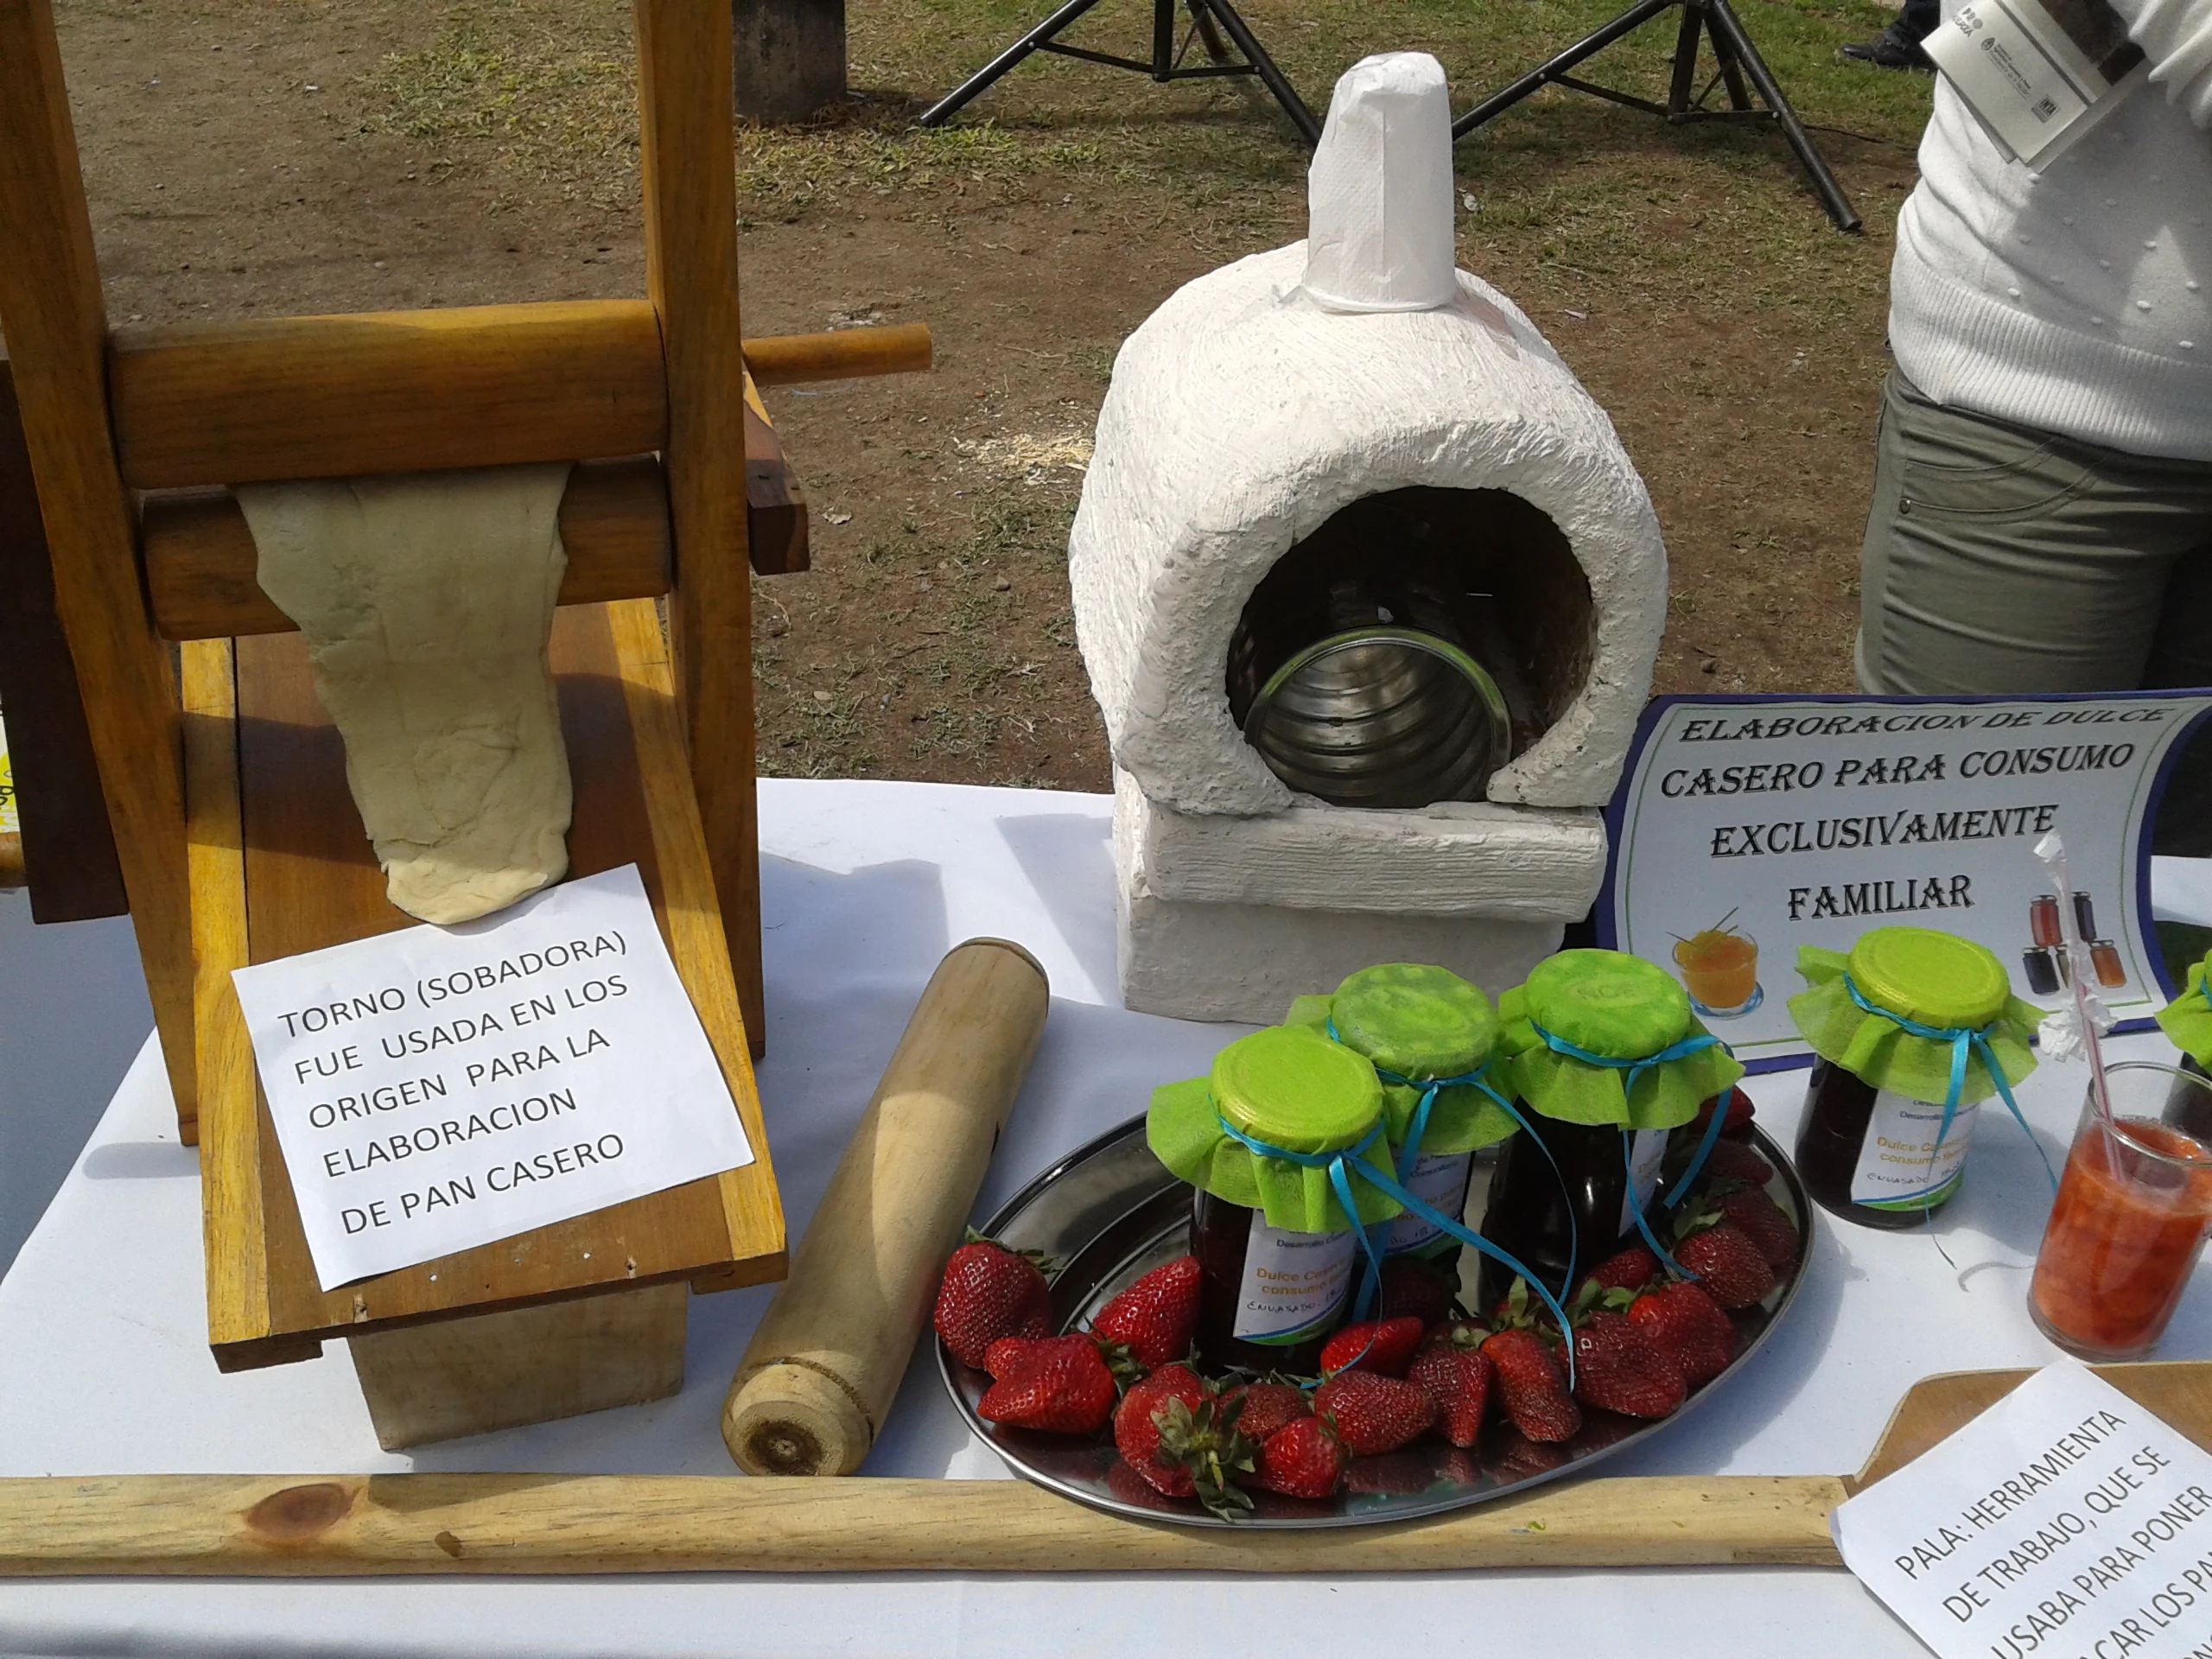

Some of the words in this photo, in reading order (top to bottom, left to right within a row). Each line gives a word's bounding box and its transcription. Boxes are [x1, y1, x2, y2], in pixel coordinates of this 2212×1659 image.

[1679, 714, 1985, 742] ELABORACION
[1982, 711, 2036, 728] DE
[2042, 707, 2175, 726] DULCE
[1661, 760, 1825, 798] CASERO
[1834, 754, 1947, 787] PARA
[1959, 743, 2135, 777] CONSUMO
[1709, 804, 2059, 858] EXCLUSIVAMENTE
[1788, 874, 1975, 921] FAMILIAR
[278, 988, 406, 1038] TORNO
[416, 930, 627, 1008] (SOBADORA)
[294, 1046, 363, 1084] FUE
[381, 1012, 504, 1058] USADA
[511, 995, 556, 1027] EN
[566, 975, 628, 1009] LOS
[308, 1074, 448, 1128] ORIGEN
[466, 1044, 560, 1087] PARA
[567, 1027, 610, 1058] LA
[322, 1088, 577, 1179] ELABORACION
[1877, 1136, 1916, 1151] Dulce
[340, 1200, 391, 1234] DE
[400, 1175, 477, 1218] PAN
[486, 1133, 625, 1192] CASERO
[1256, 1268, 1300, 1281] Dulce
[1262, 1282, 1326, 1295] consumo
[1894, 1524, 1974, 1580] PALA:
[1961, 1410, 2126, 1530] HERRAMIENTA
[1942, 1582, 1990, 1624] DE
[1977, 1512, 2098, 1590] TRABAJO,
[2083, 1466, 2143, 1514] QUE
[2131, 1446, 2171, 1476] SE
[1991, 1591, 2086, 1659] USABA
[2073, 1547, 2145, 1599] PARA
[2131, 1486, 2212, 1553] PONER
[2139, 1583, 2195, 1628] LOS
